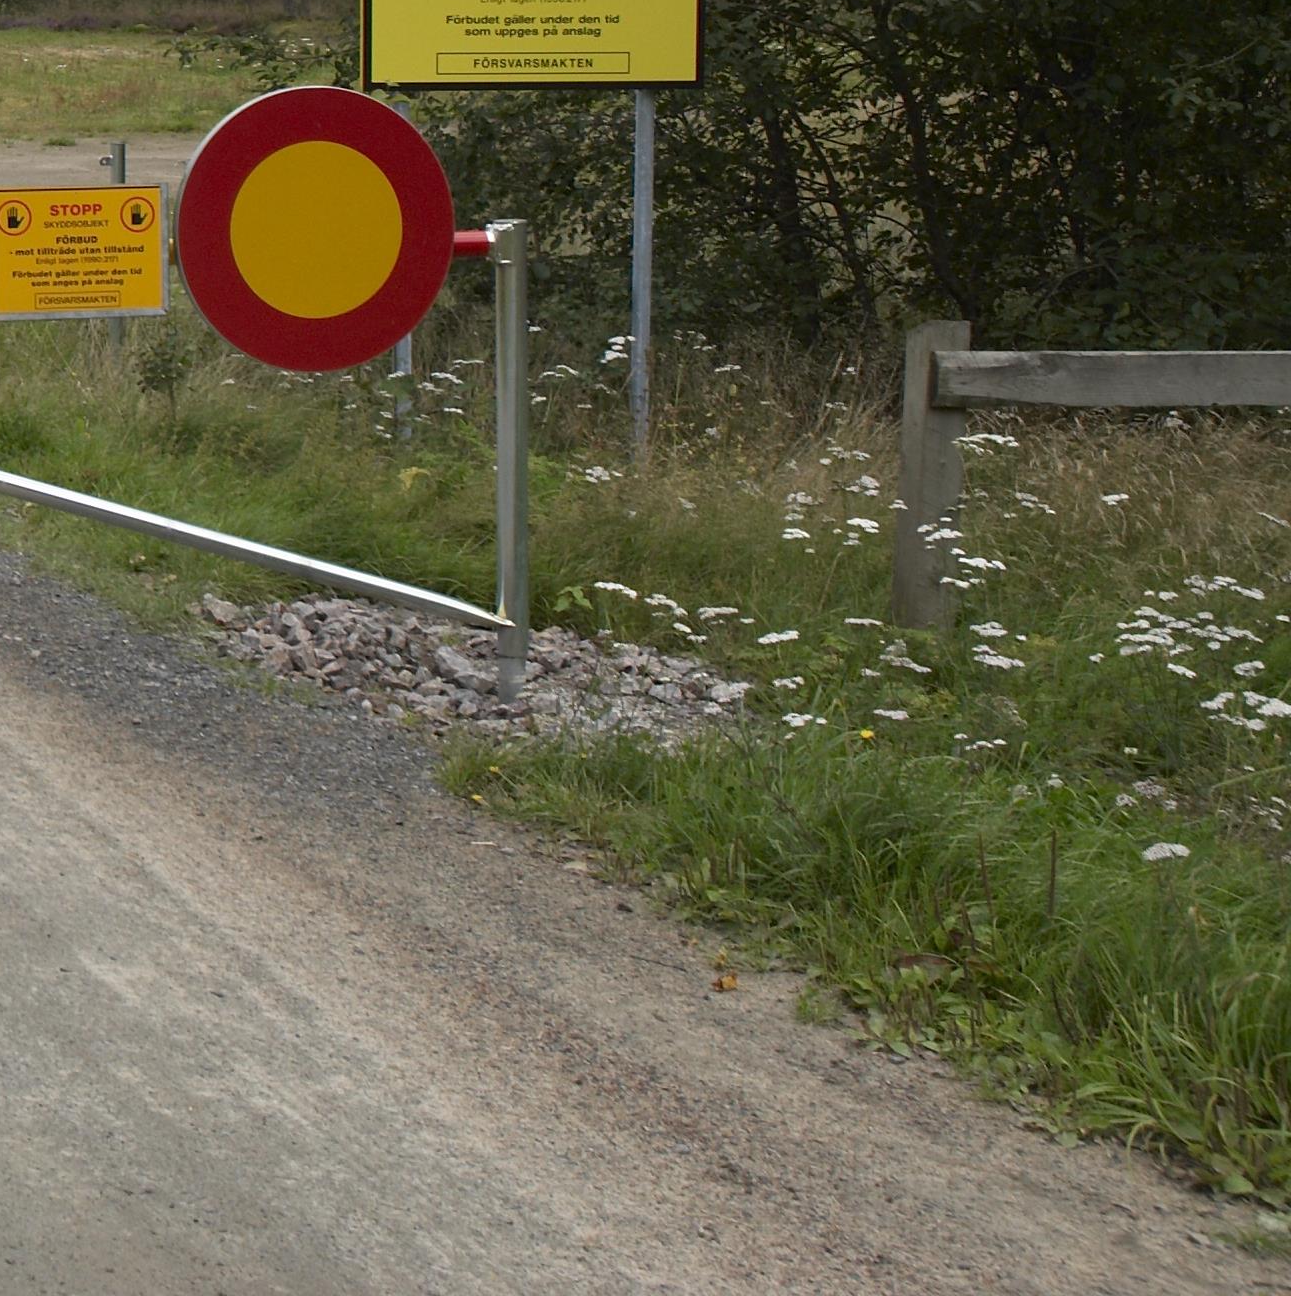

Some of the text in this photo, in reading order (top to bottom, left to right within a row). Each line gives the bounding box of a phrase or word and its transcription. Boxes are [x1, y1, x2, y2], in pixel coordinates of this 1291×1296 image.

[446, 14, 620, 27] Förbudet gäller under den tid
[465, 25, 602, 39] som uppges på anslag
[473, 56, 594, 69] FÖRSVARSMAKTEN
[49, 204, 103, 216] STOPP
[43, 220, 109, 229] SKYDDSOBJEKT
[55, 235, 98, 245] FÖRBUD
[37, 247, 76, 256] tillträde
[79, 246, 101, 254] utan
[104, 245, 144, 254] tillstånd
[12, 270, 52, 279] Förbudet
[82, 268, 109, 276] under
[130, 267, 142, 275] tid
